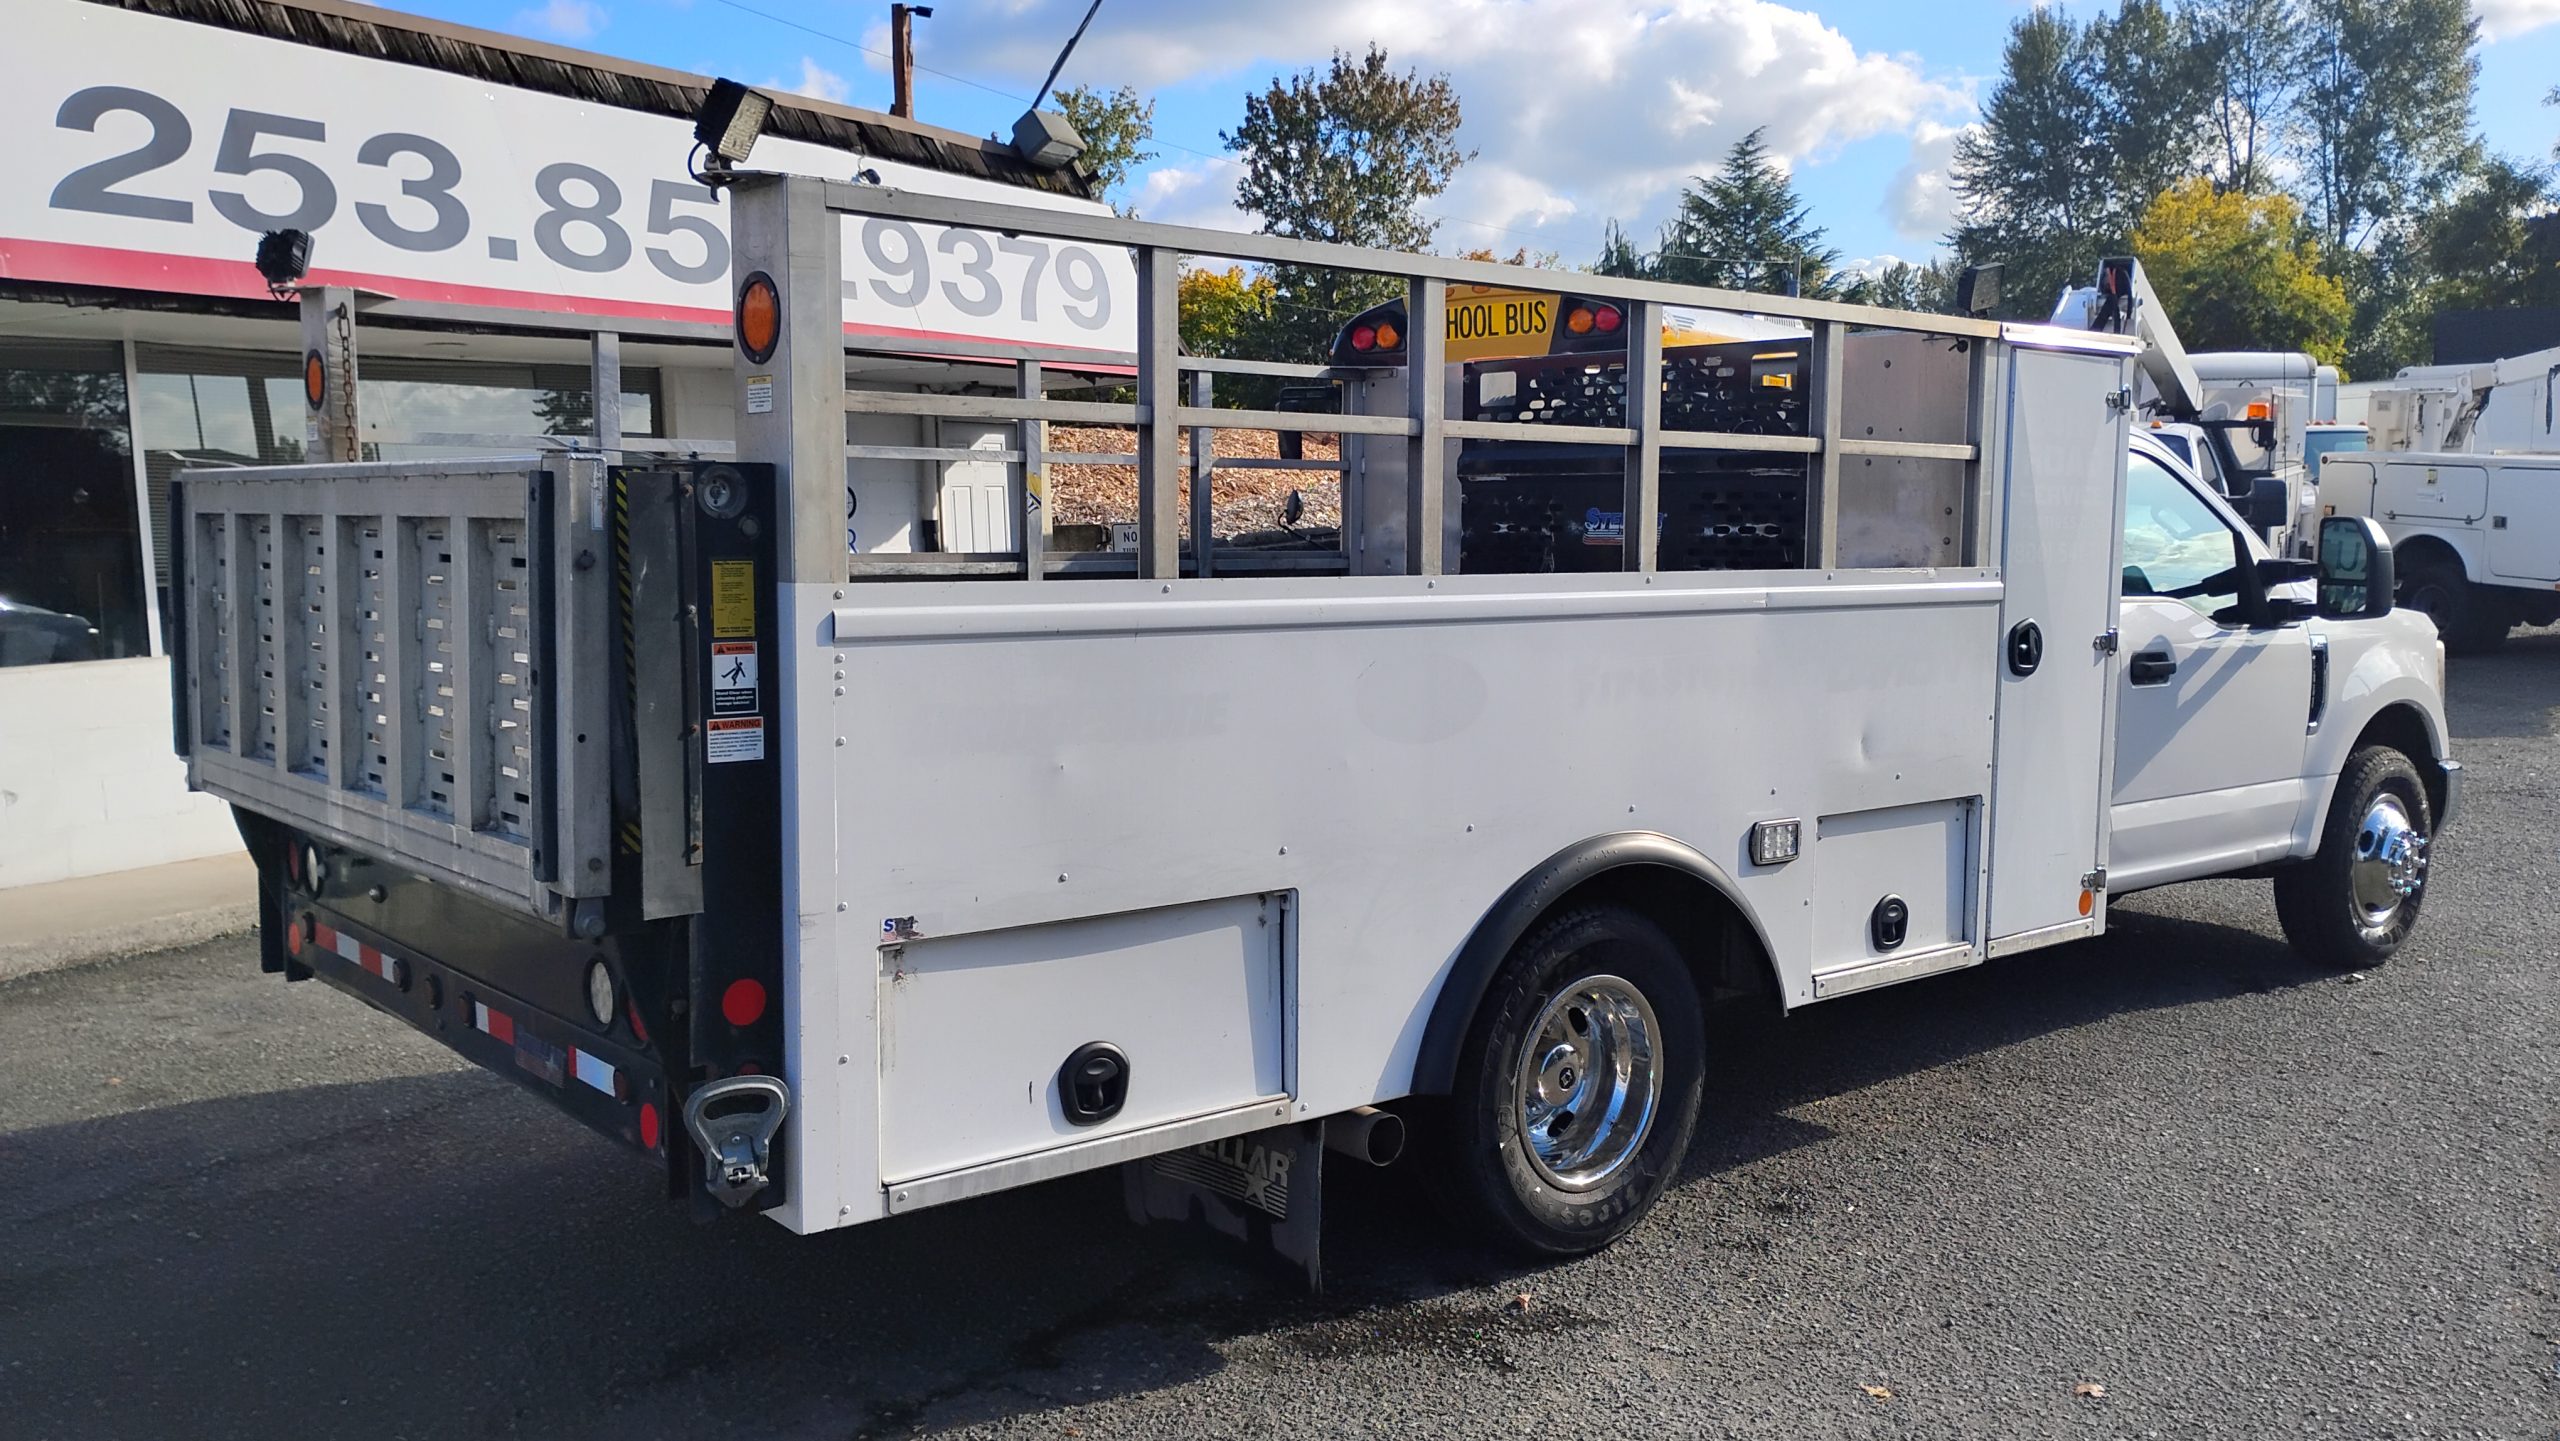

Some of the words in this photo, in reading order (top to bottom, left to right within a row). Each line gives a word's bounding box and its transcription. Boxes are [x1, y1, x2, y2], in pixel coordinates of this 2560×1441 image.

[48, 84, 1112, 331] 253.85.9379
[1446, 303, 1499, 340] HOOL
[1505, 300, 1547, 335] BUS
[1123, 531, 1138, 543] NO
[722, 719, 760, 729] WARNING
[1201, 1137, 1290, 1187] ELLAR
